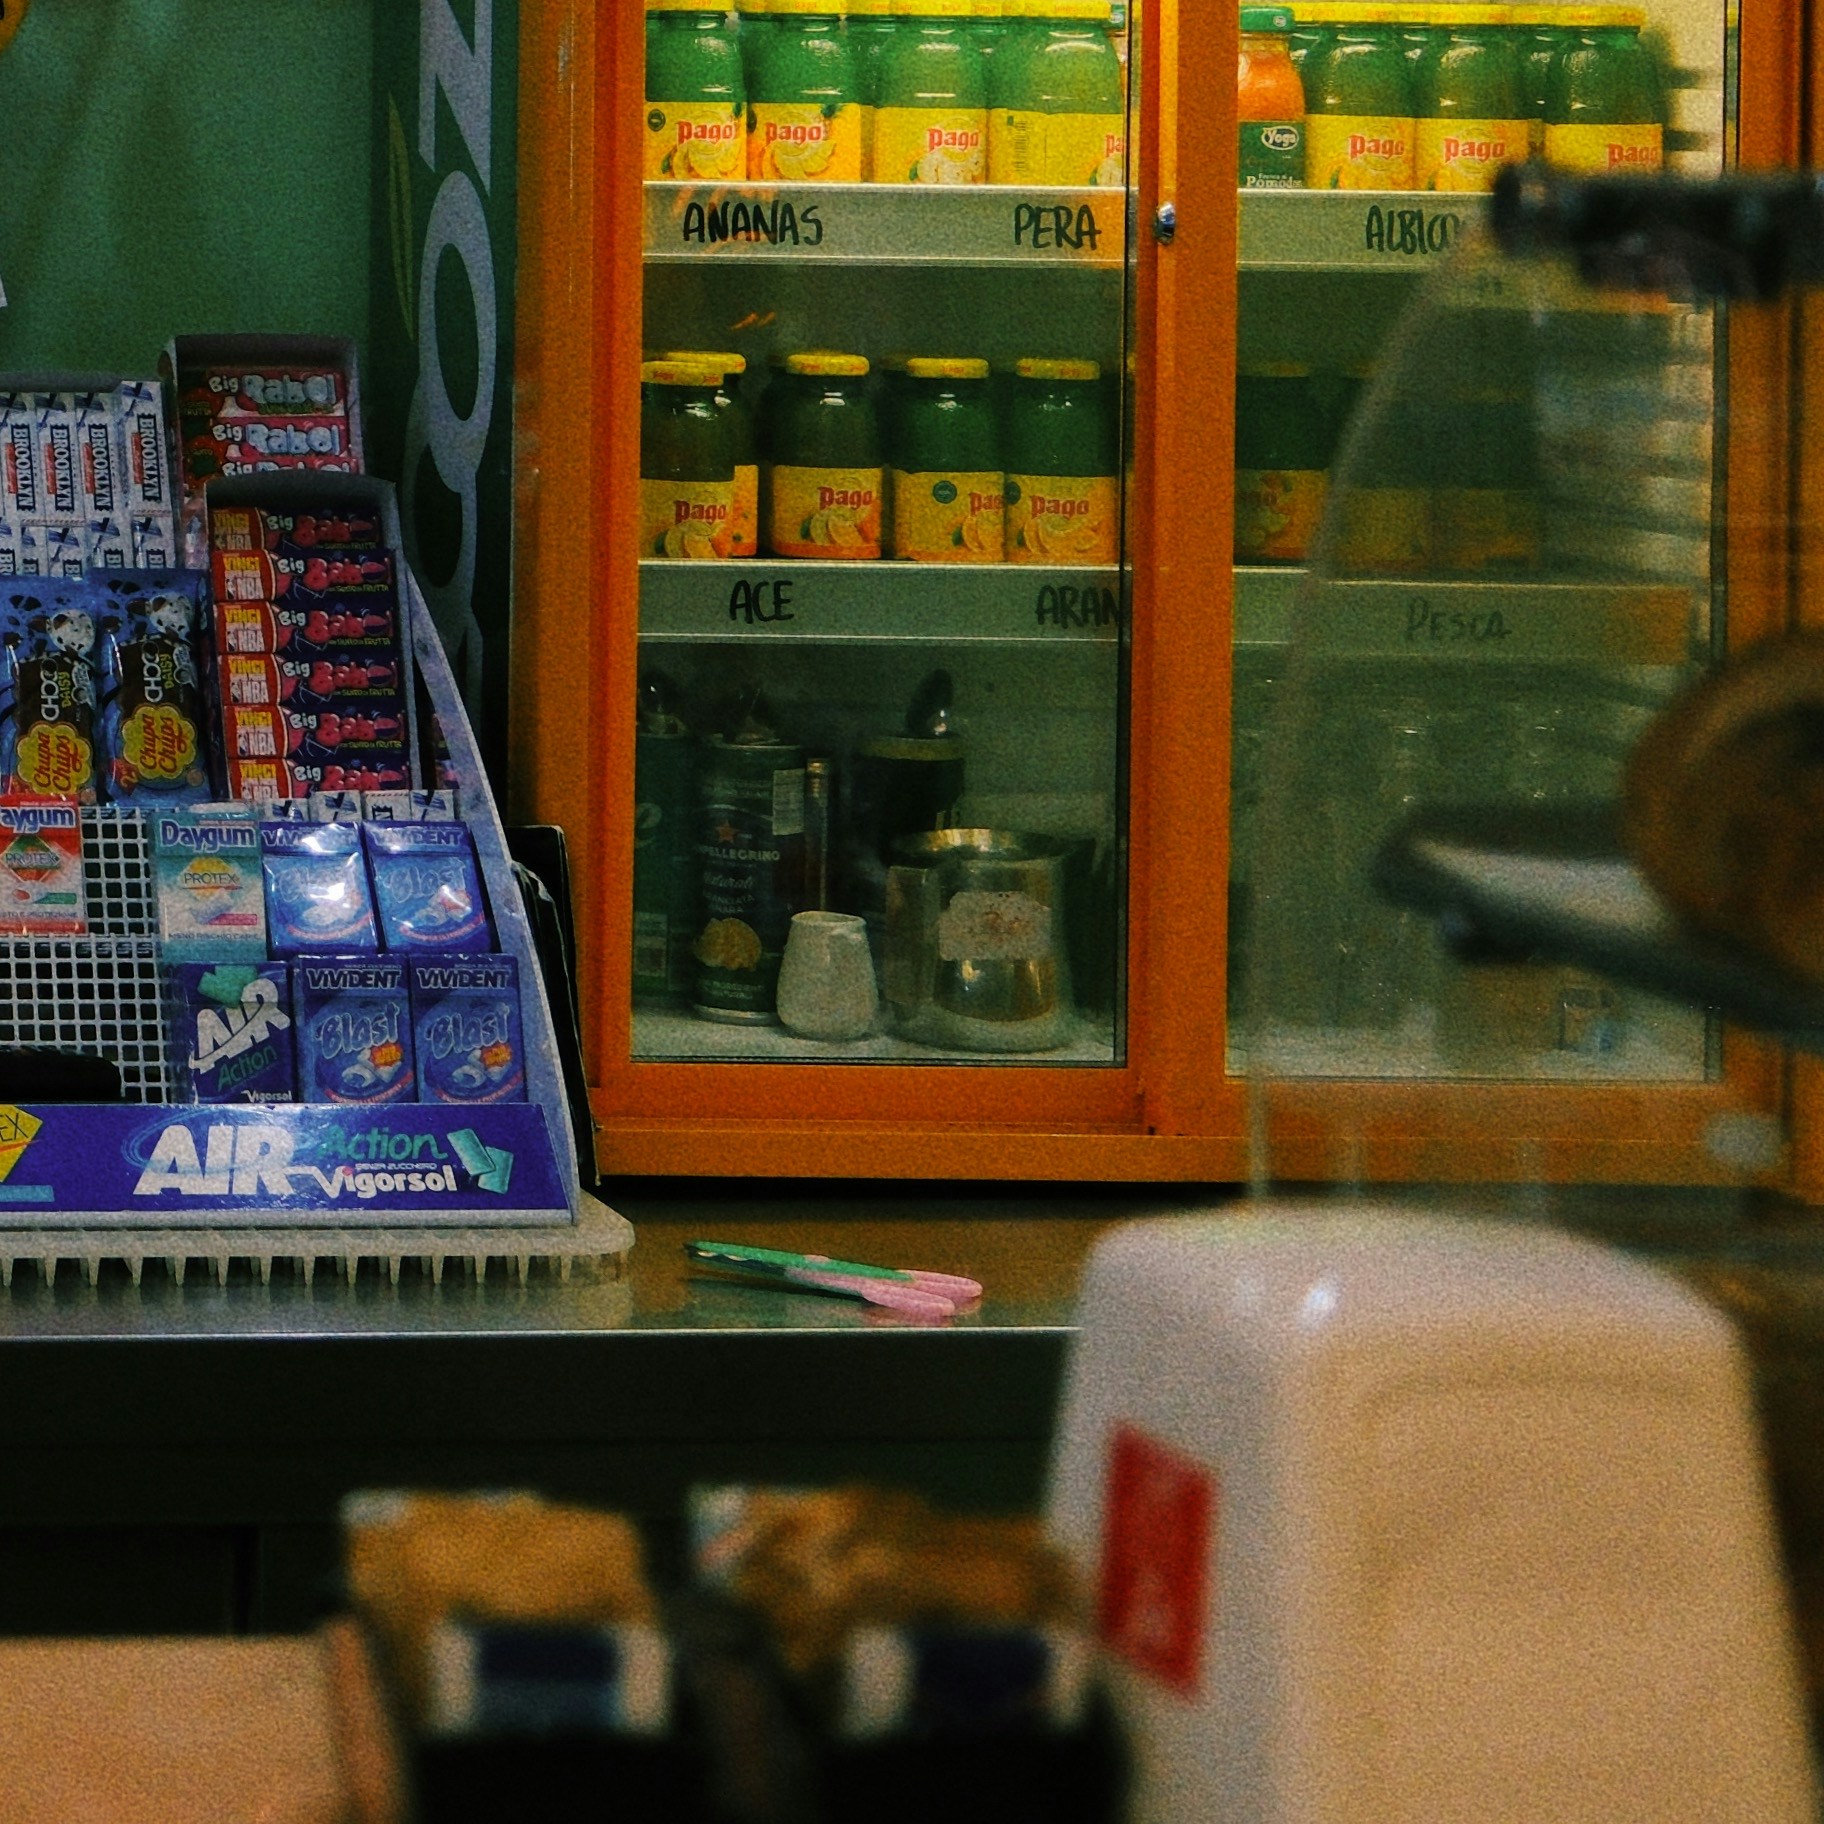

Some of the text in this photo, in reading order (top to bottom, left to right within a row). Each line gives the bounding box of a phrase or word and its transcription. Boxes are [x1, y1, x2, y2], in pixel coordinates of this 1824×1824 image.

[676, 118, 739, 146] pago
[765, 120, 824, 146] pago
[927, 126, 980, 153] pago
[1443, 135, 1506, 162] pago
[682, 200, 824, 247] ANANAS
[1013, 202, 1102, 250] PERA
[208, 376, 240, 393] Big
[212, 424, 243, 441] Big
[10, 421, 36, 513] BROOKLYN
[51, 423, 76, 513] BROOKLYN
[88, 422, 115, 513] BROOKLYN
[135, 411, 162, 503] BROOKLYN
[1030, 495, 1091, 518] pago
[277, 557, 305, 575] Big
[278, 611, 307, 626] Big
[729, 579, 795, 624] ACE
[32, 731, 53, 789] Chupa
[51, 733, 85, 792] Chups
[139, 712, 157, 770] Chupa
[157, 715, 189, 773] Chups
[159, 823, 256, 854] Daygum
[183, 871, 237, 885] PROTEX
[188, 979, 290, 1073] AIR
[317, 1001, 400, 1060] Blast
[430, 1001, 510, 1060] Blast
[216, 1044, 278, 1091] Action
[132, 1123, 298, 1198] AIR
[318, 1127, 448, 1164] Action
[297, 1165, 457, 1199] Vigorsol
